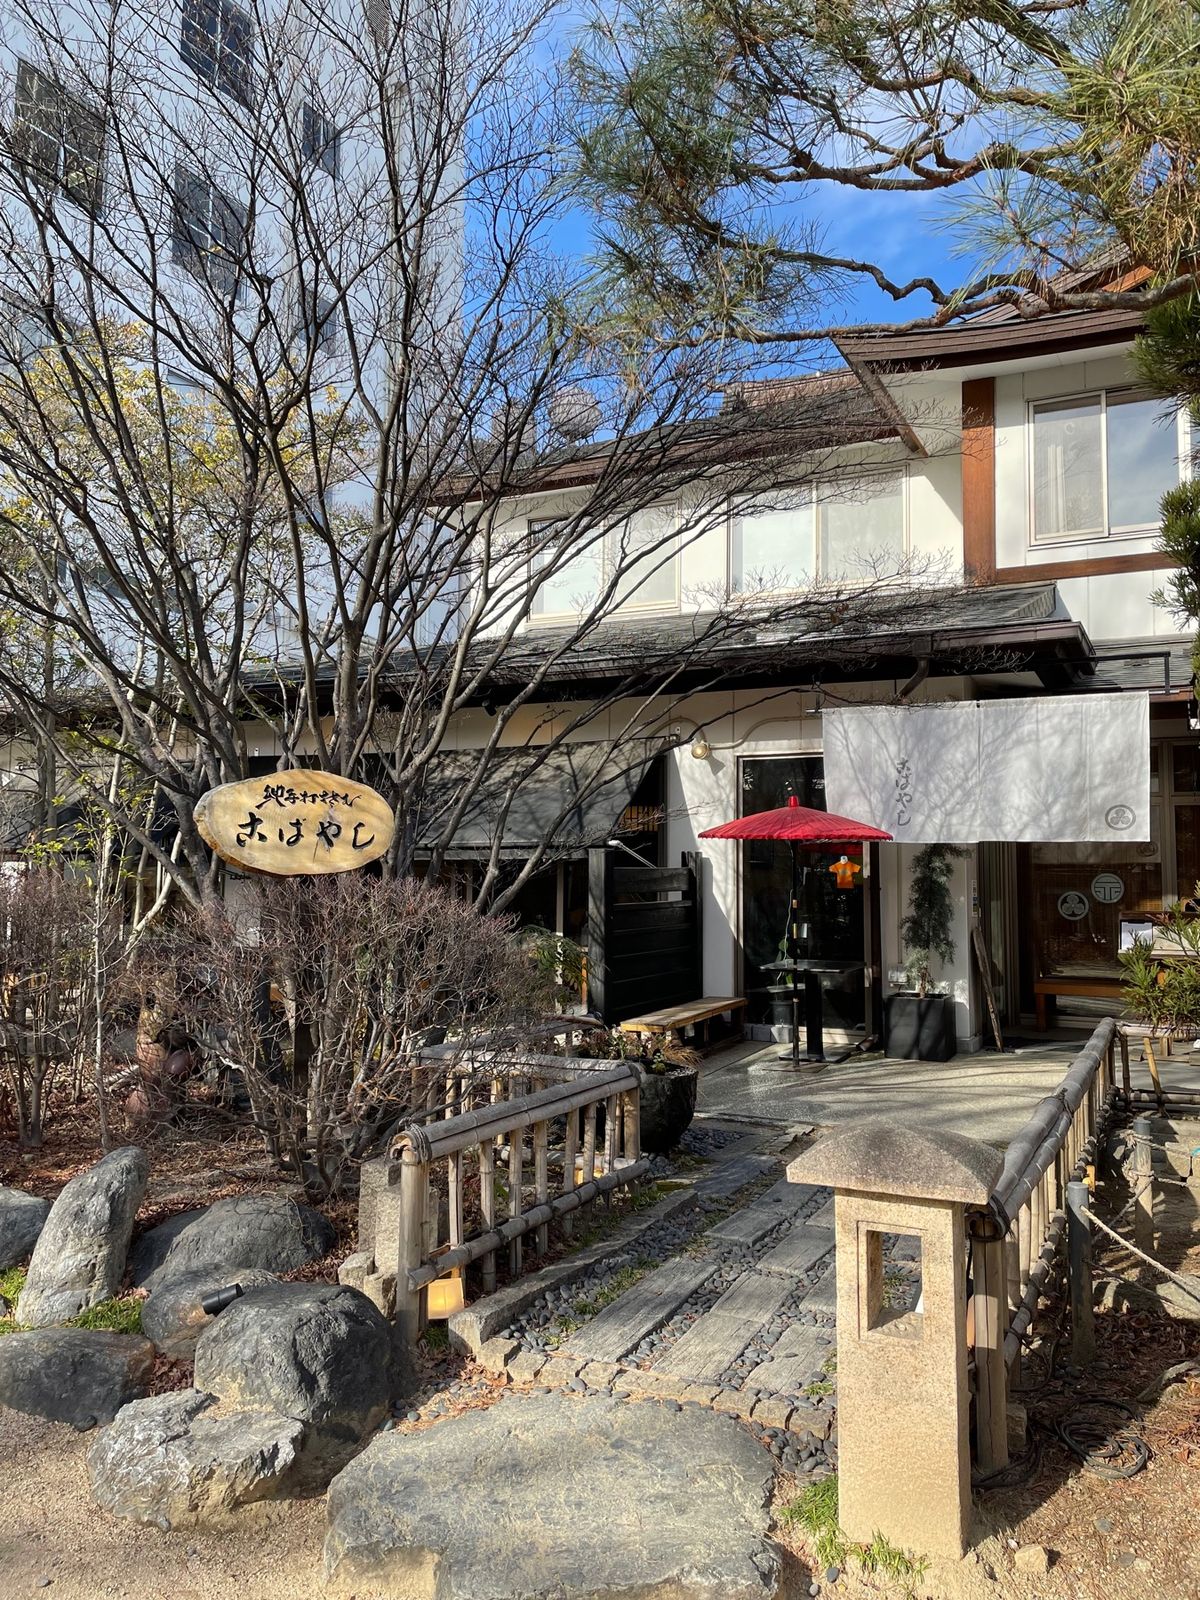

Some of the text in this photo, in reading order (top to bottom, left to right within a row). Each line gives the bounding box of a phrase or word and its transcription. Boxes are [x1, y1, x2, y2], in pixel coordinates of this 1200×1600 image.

[896, 758, 912, 826] こばやし
[236, 811, 375, 850] こばやし
